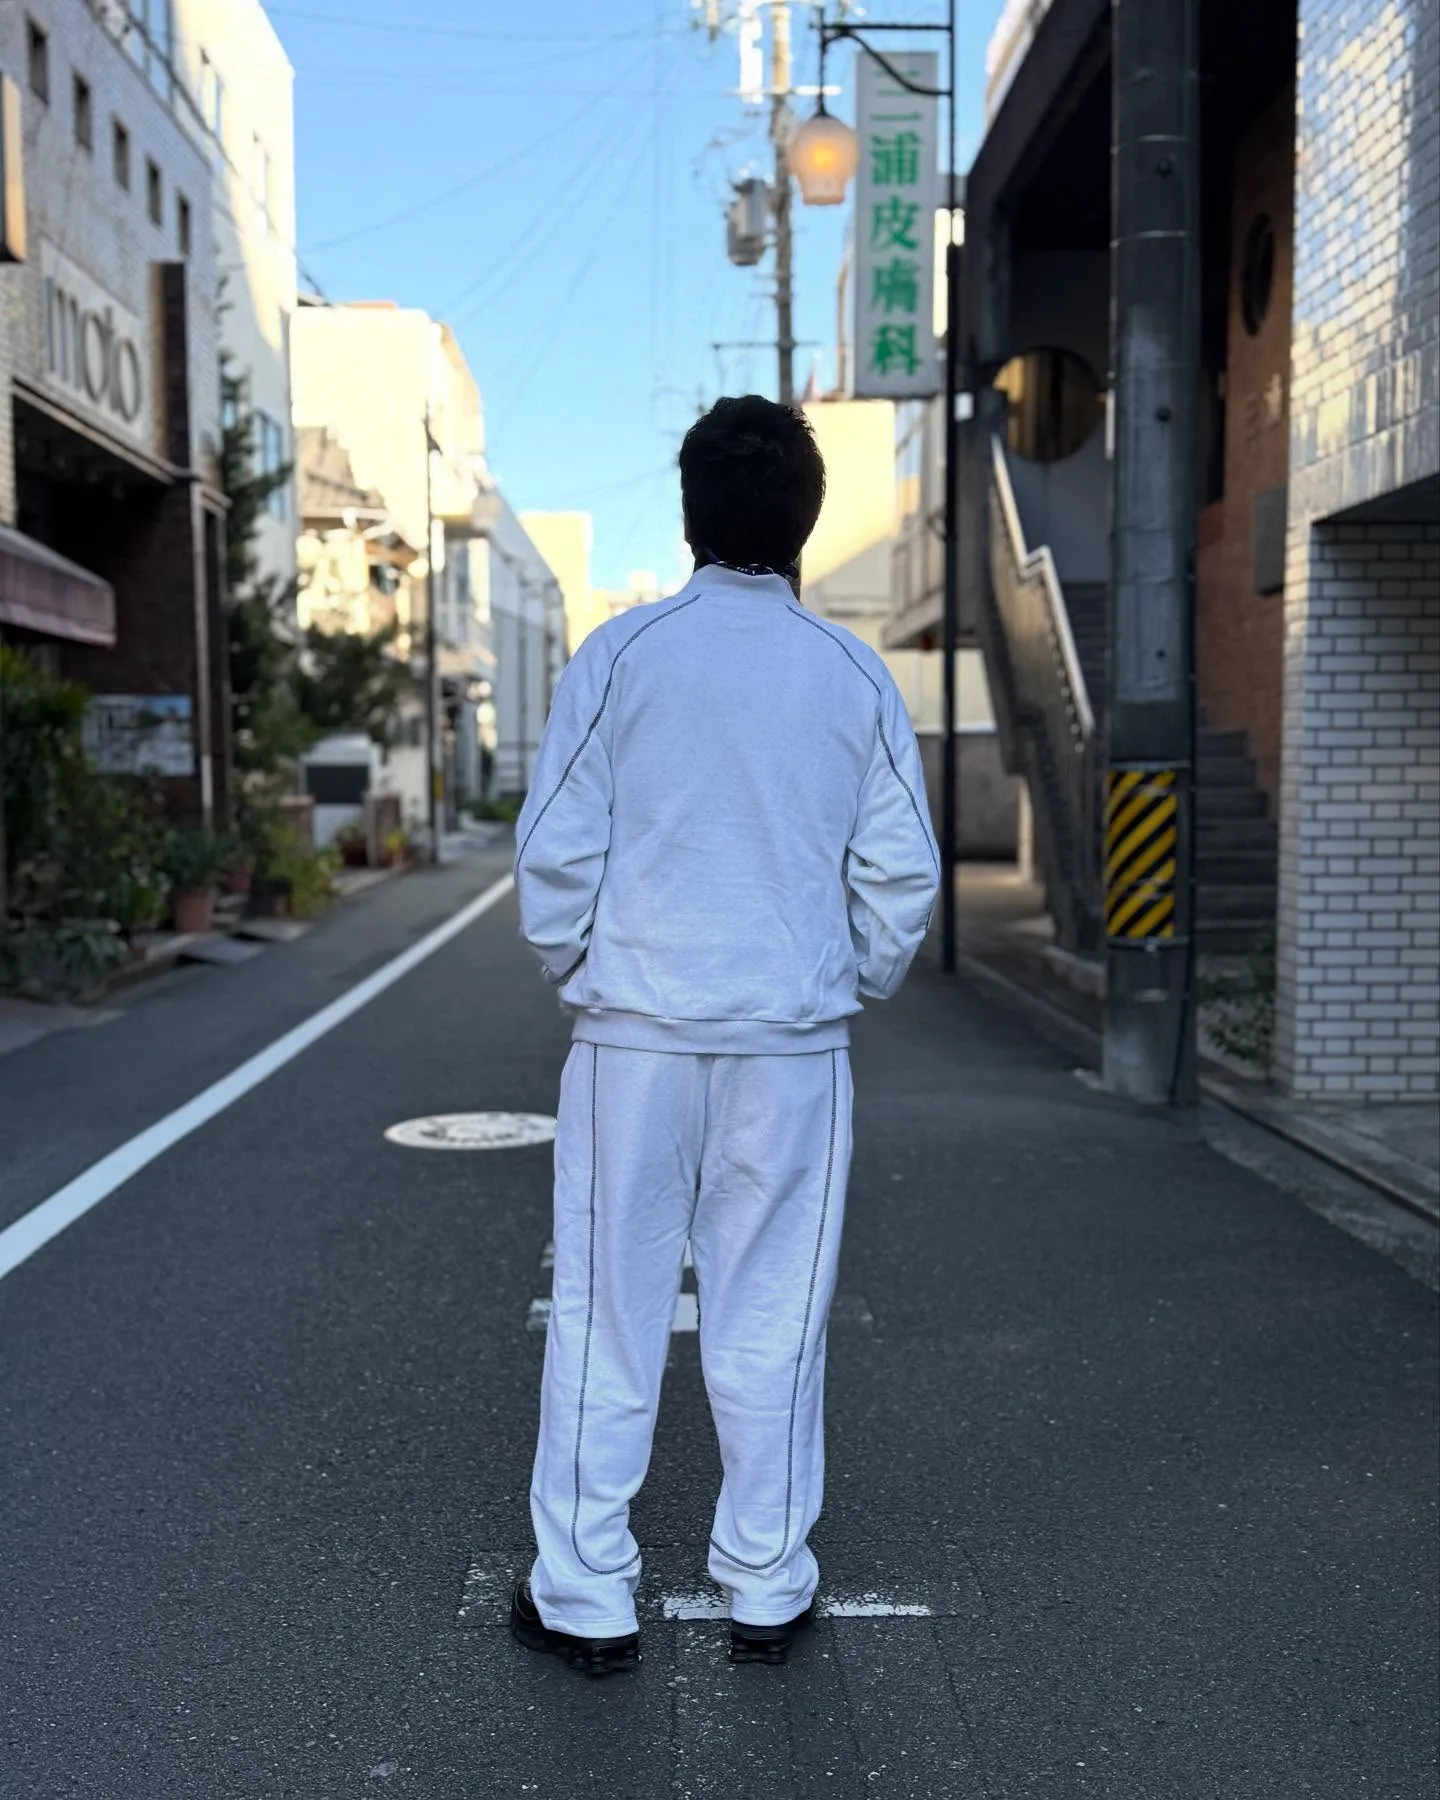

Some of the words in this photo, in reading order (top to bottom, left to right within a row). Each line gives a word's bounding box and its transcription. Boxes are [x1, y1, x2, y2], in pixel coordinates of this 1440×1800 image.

[869, 67, 923, 376] 三浦皮膚科
[45, 276, 141, 423] moto
